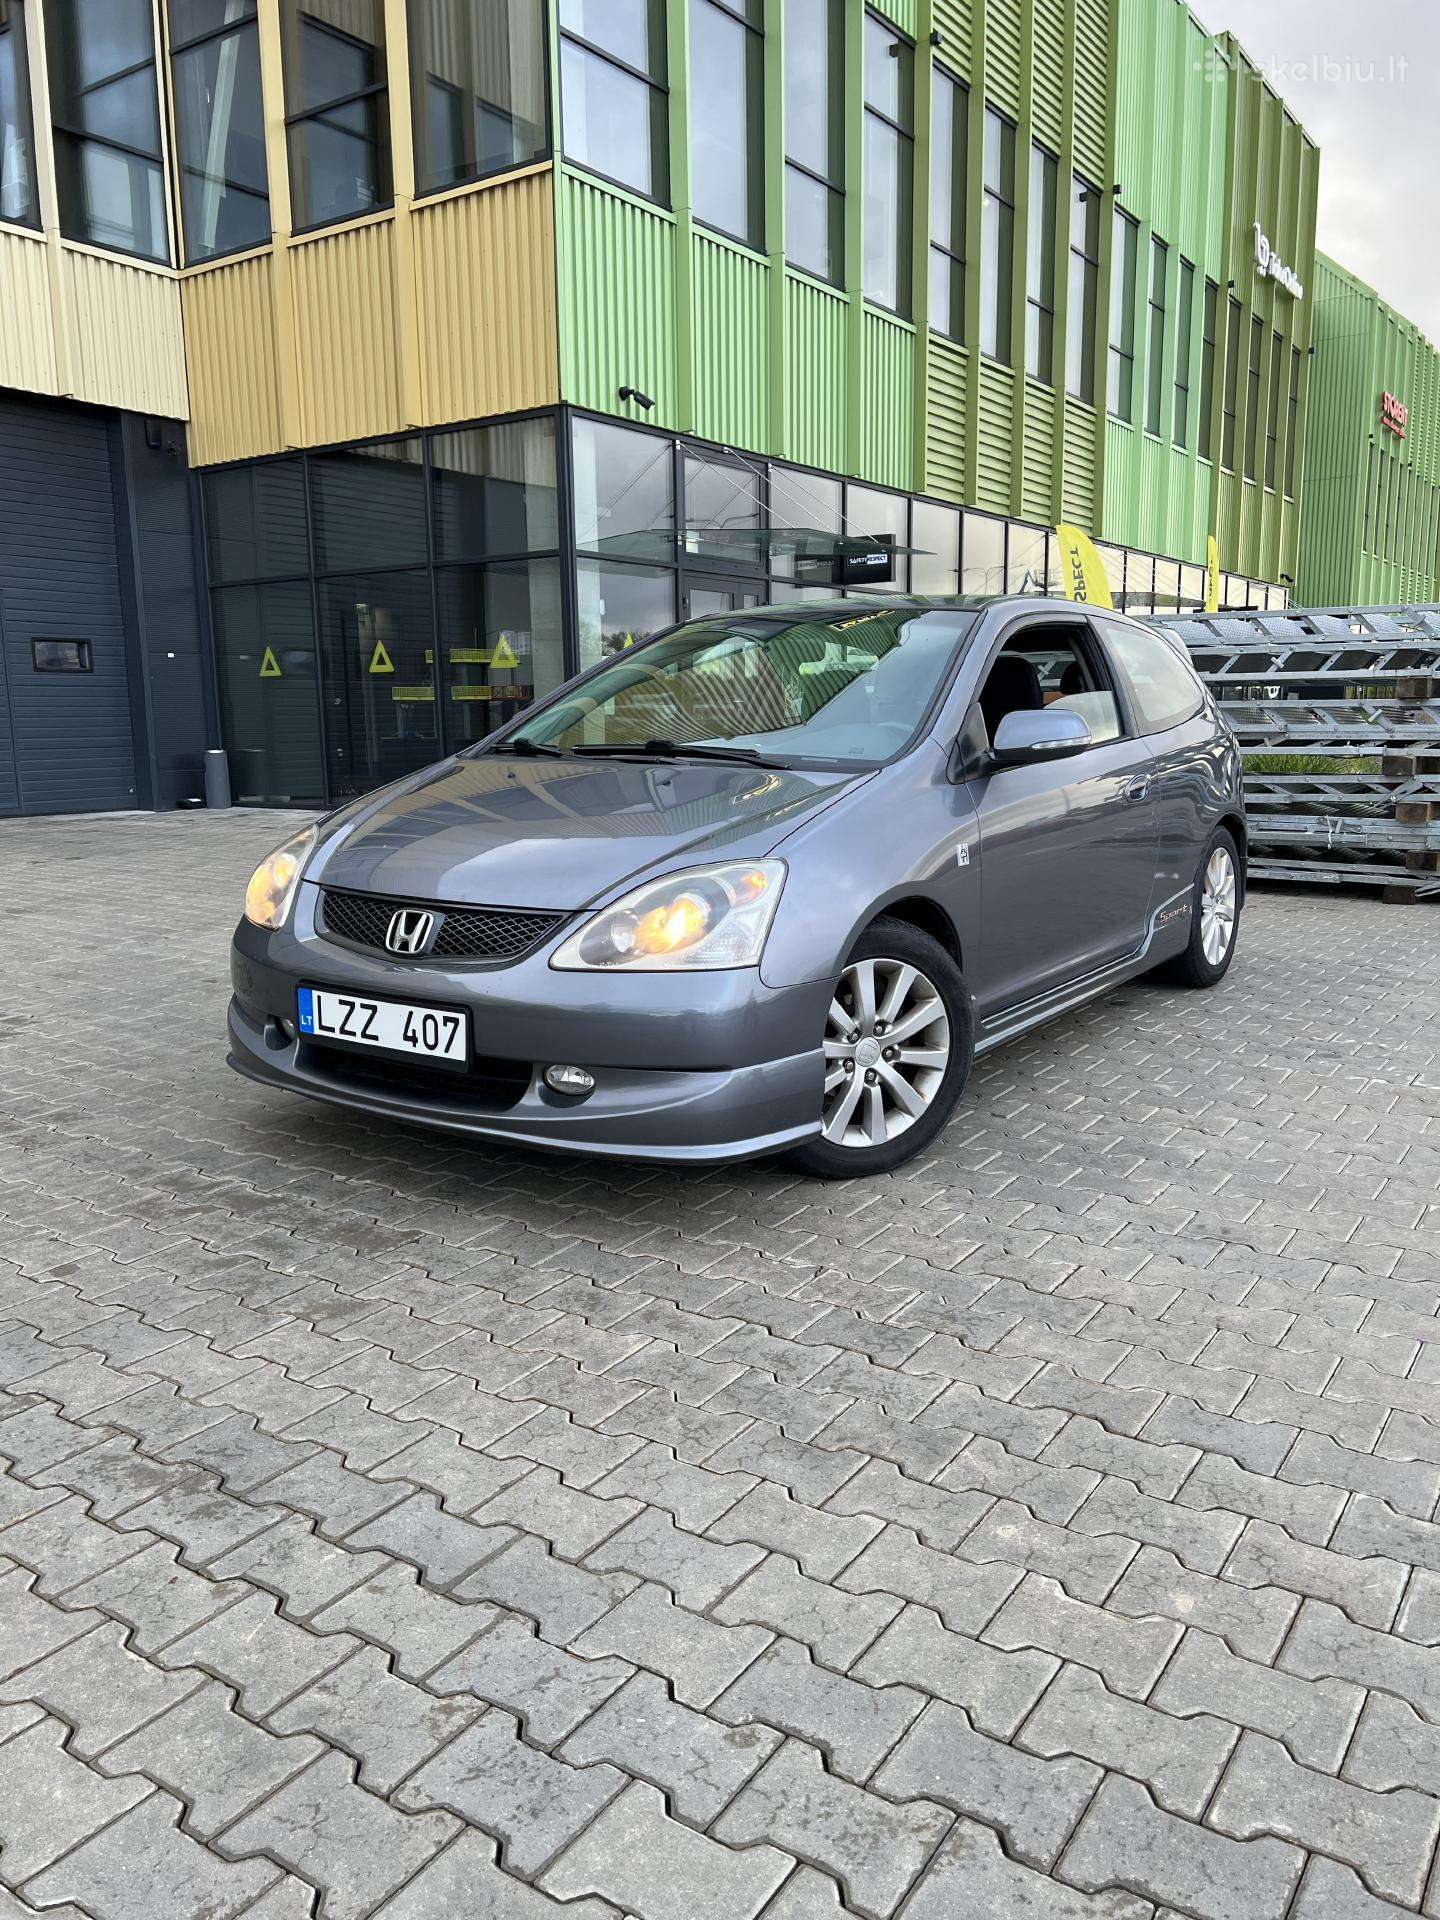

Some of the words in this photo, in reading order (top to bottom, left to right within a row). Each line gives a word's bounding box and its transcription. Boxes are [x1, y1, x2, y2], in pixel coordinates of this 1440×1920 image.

[1159, 904, 1187, 923] Sport
[300, 1014, 313, 1027] LT
[316, 995, 379, 1041] LZZ
[402, 1010, 460, 1053] 407
